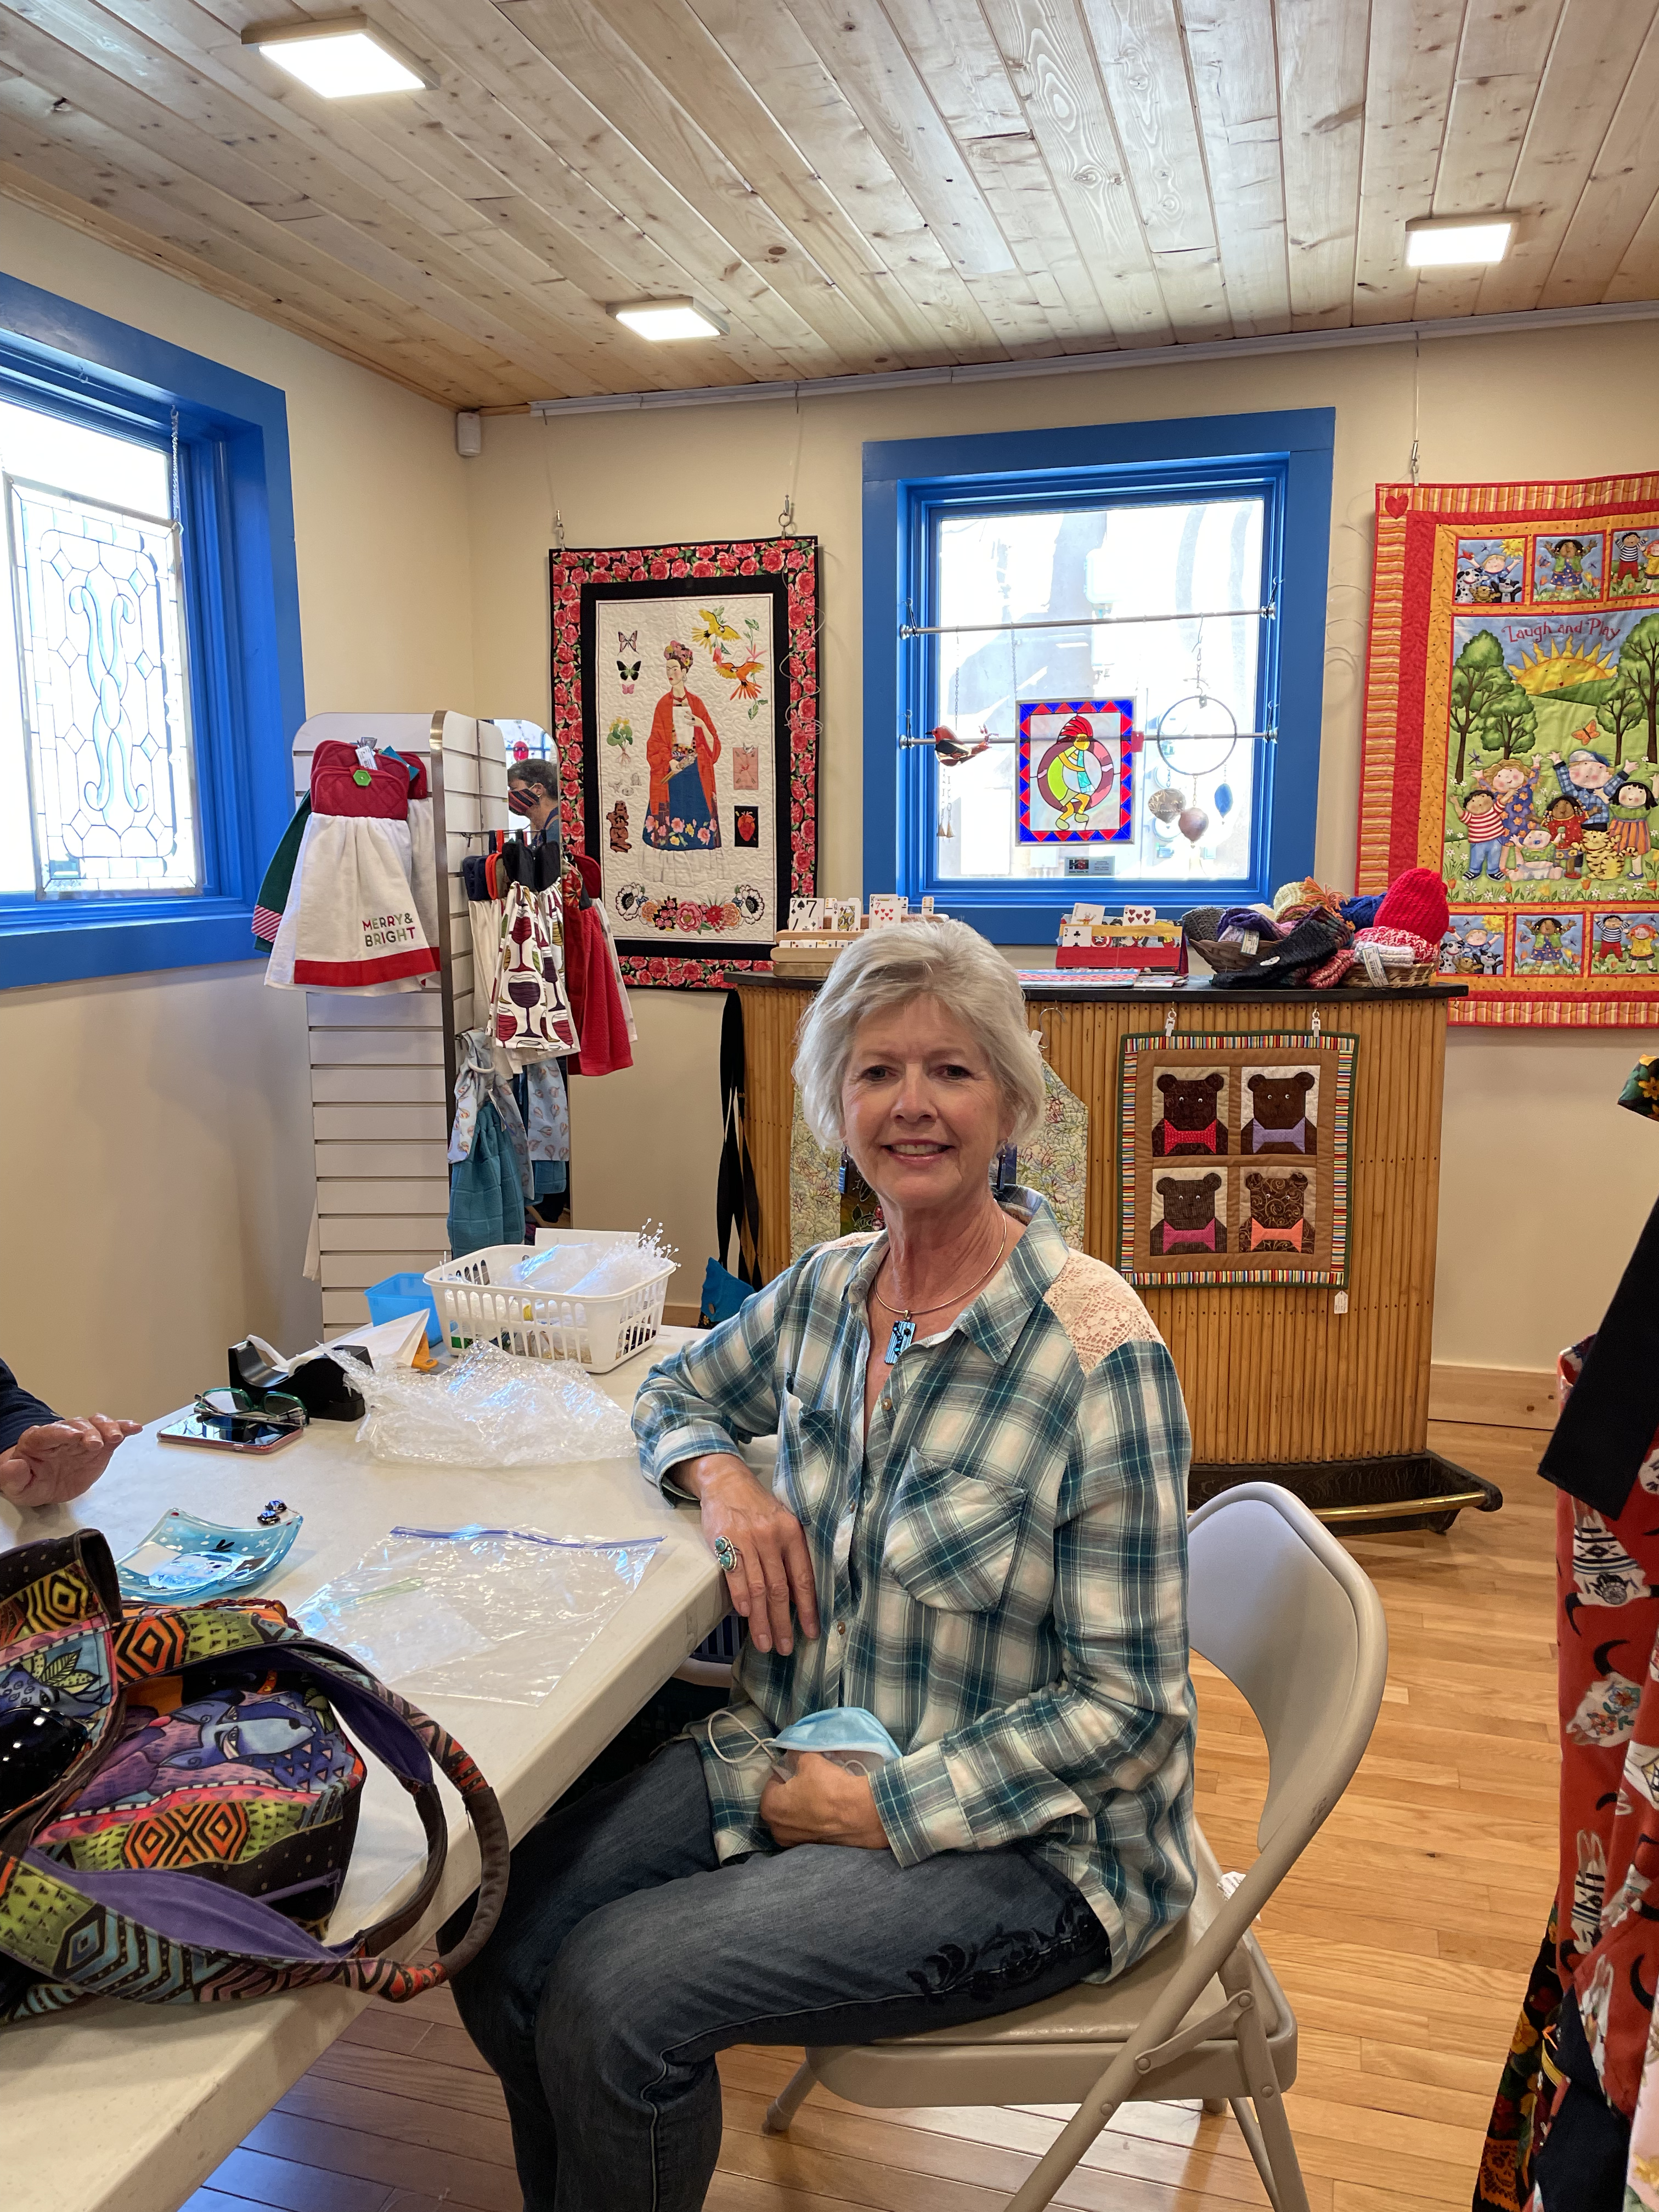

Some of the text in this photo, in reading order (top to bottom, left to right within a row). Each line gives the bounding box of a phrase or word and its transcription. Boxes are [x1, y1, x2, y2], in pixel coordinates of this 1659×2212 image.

[1501, 618, 1621, 643] Laugh and Play
[791, 899, 797, 908] 7
[806, 900, 817, 918] 7
[362, 912, 413, 932] MERRY &
[364, 927, 416, 947] BRIGHT
